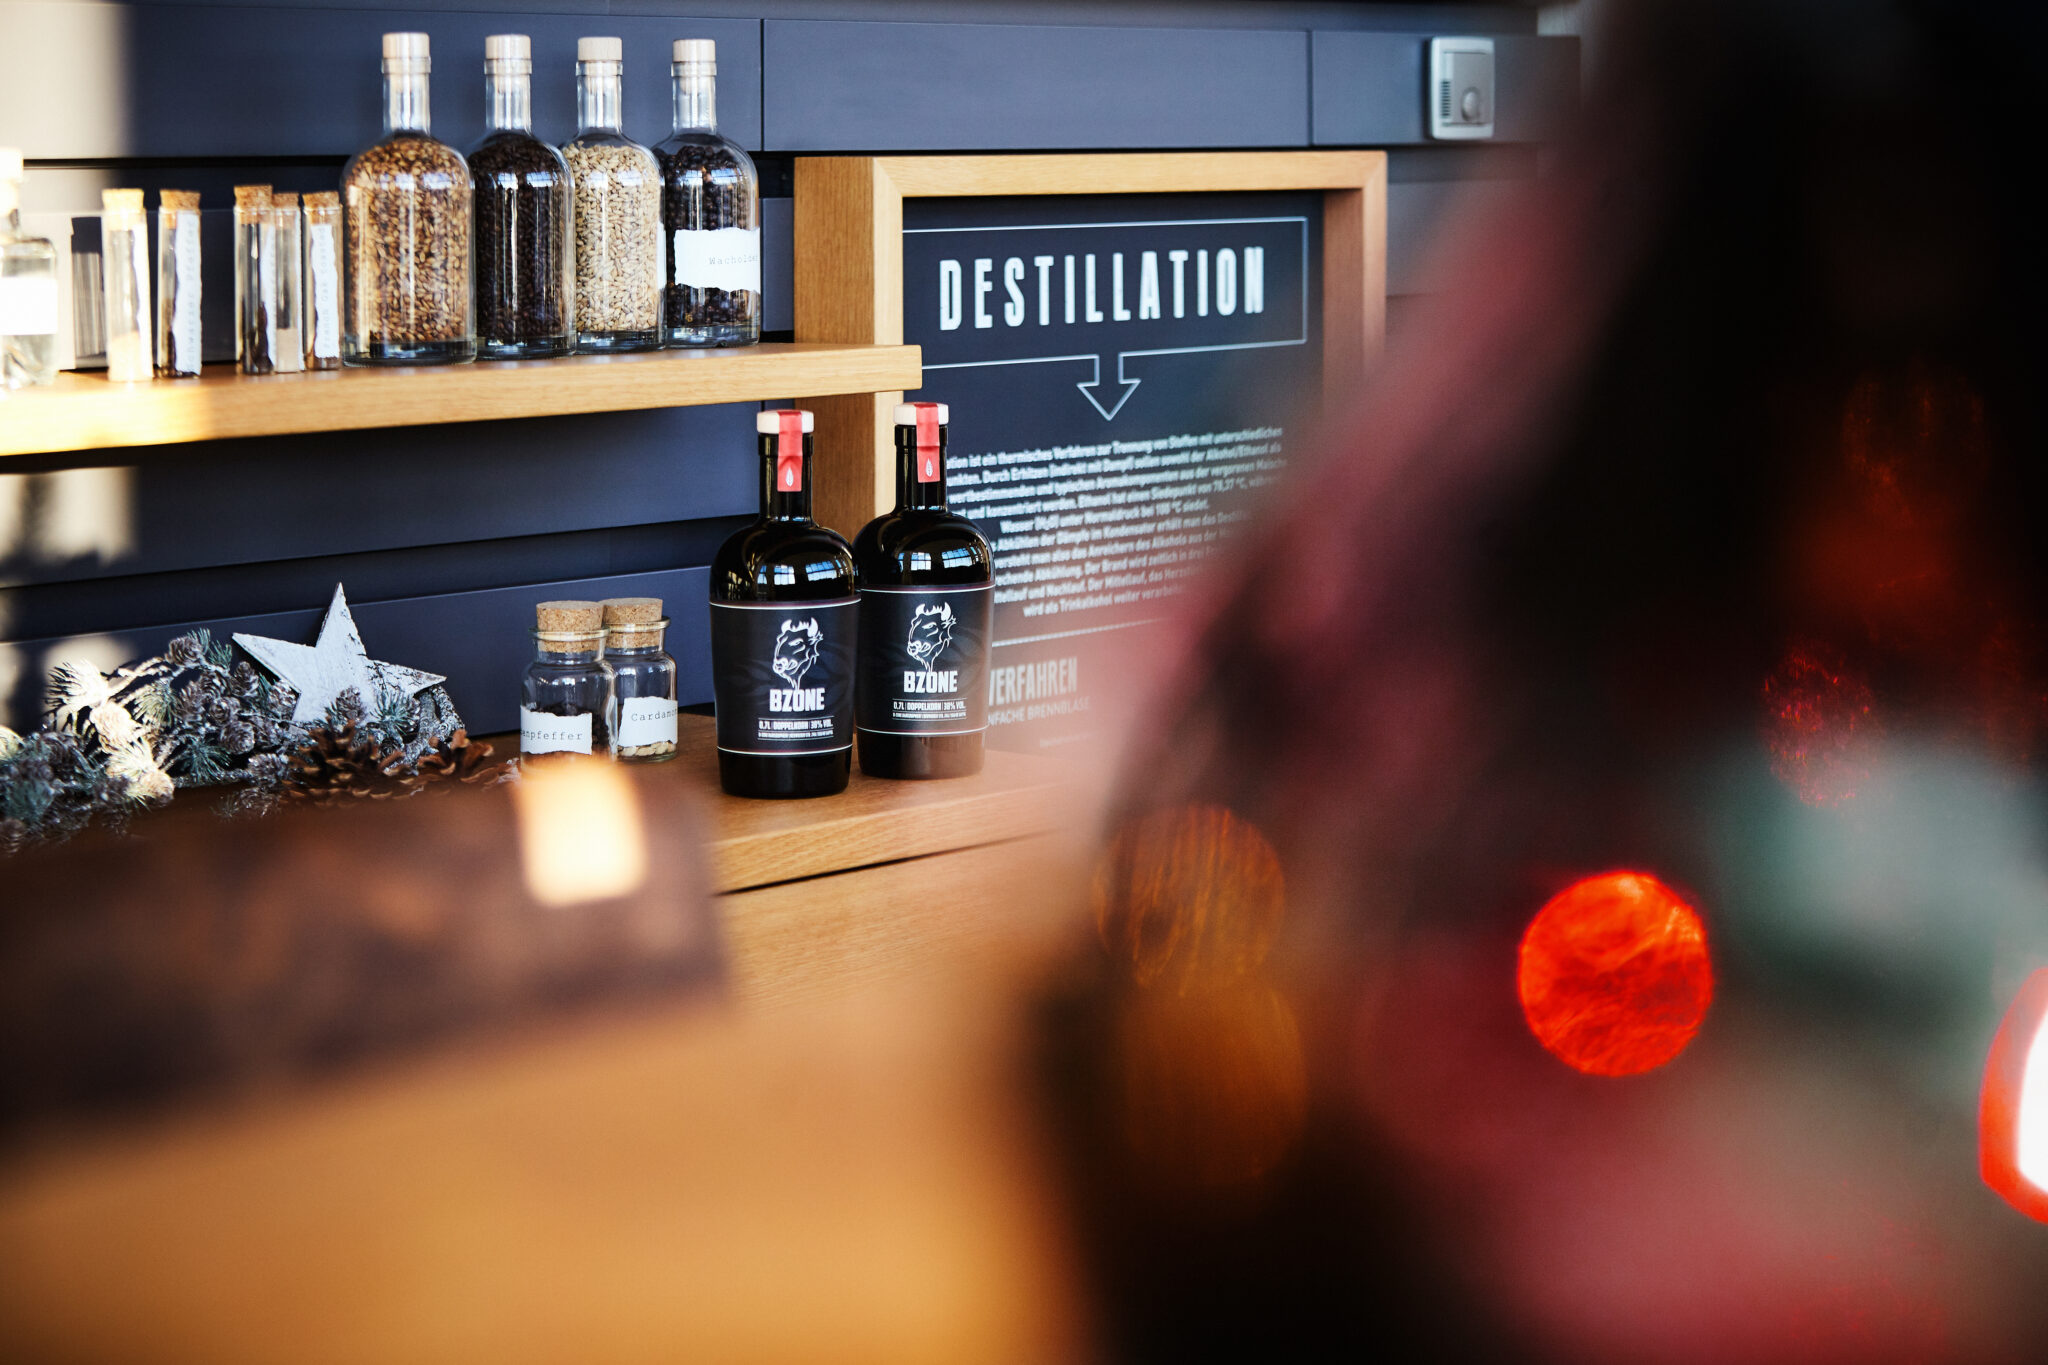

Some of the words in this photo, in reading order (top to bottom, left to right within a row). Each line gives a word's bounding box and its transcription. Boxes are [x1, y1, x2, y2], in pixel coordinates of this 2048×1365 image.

[939, 246, 1265, 331] DESTILLATION
[903, 670, 958, 693] BZONE
[769, 687, 826, 712] BZONE
[907, 701, 941, 711] DOPPELKORN
[988, 705, 1025, 726] NFACHE
